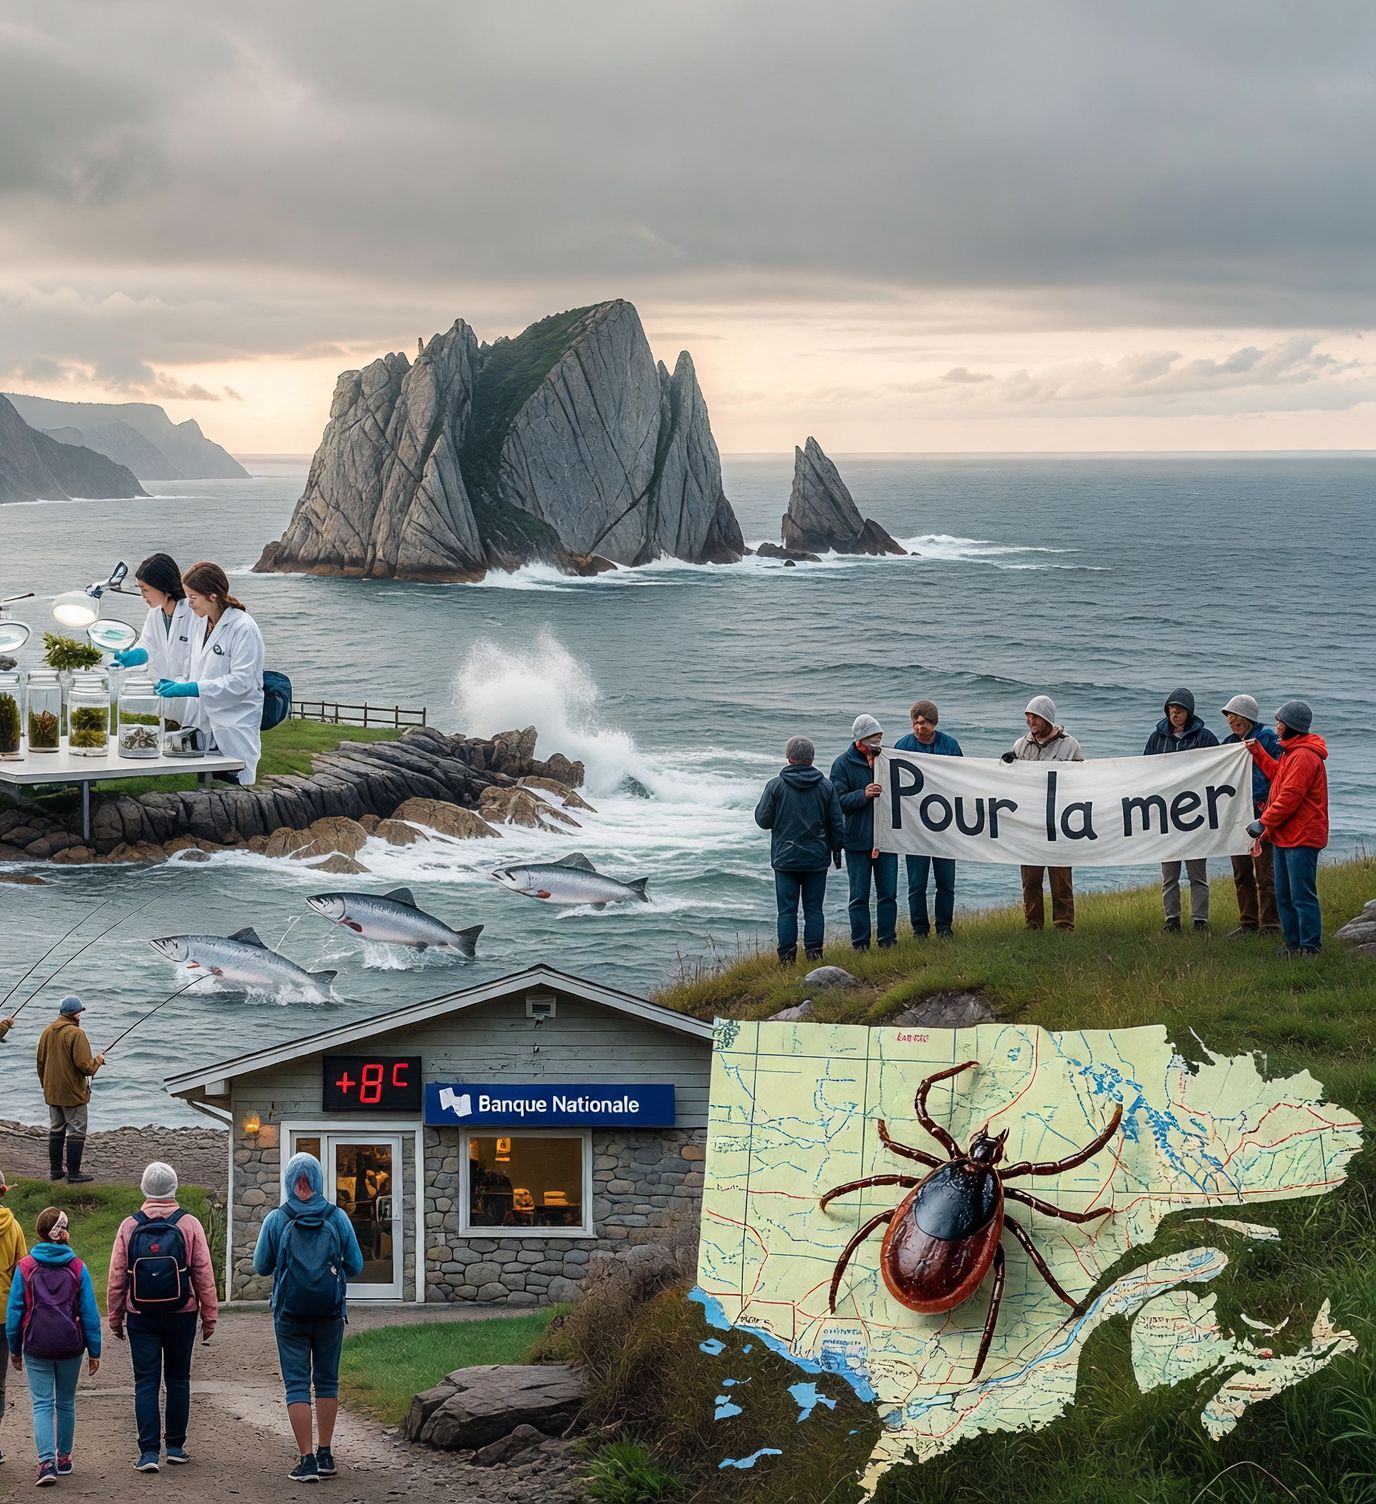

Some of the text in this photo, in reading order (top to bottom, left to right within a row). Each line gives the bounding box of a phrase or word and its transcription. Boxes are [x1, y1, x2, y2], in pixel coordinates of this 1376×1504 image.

[889, 758, 1236, 842] Pour la mer
[478, 1094, 640, 1118] Banque Nationale
